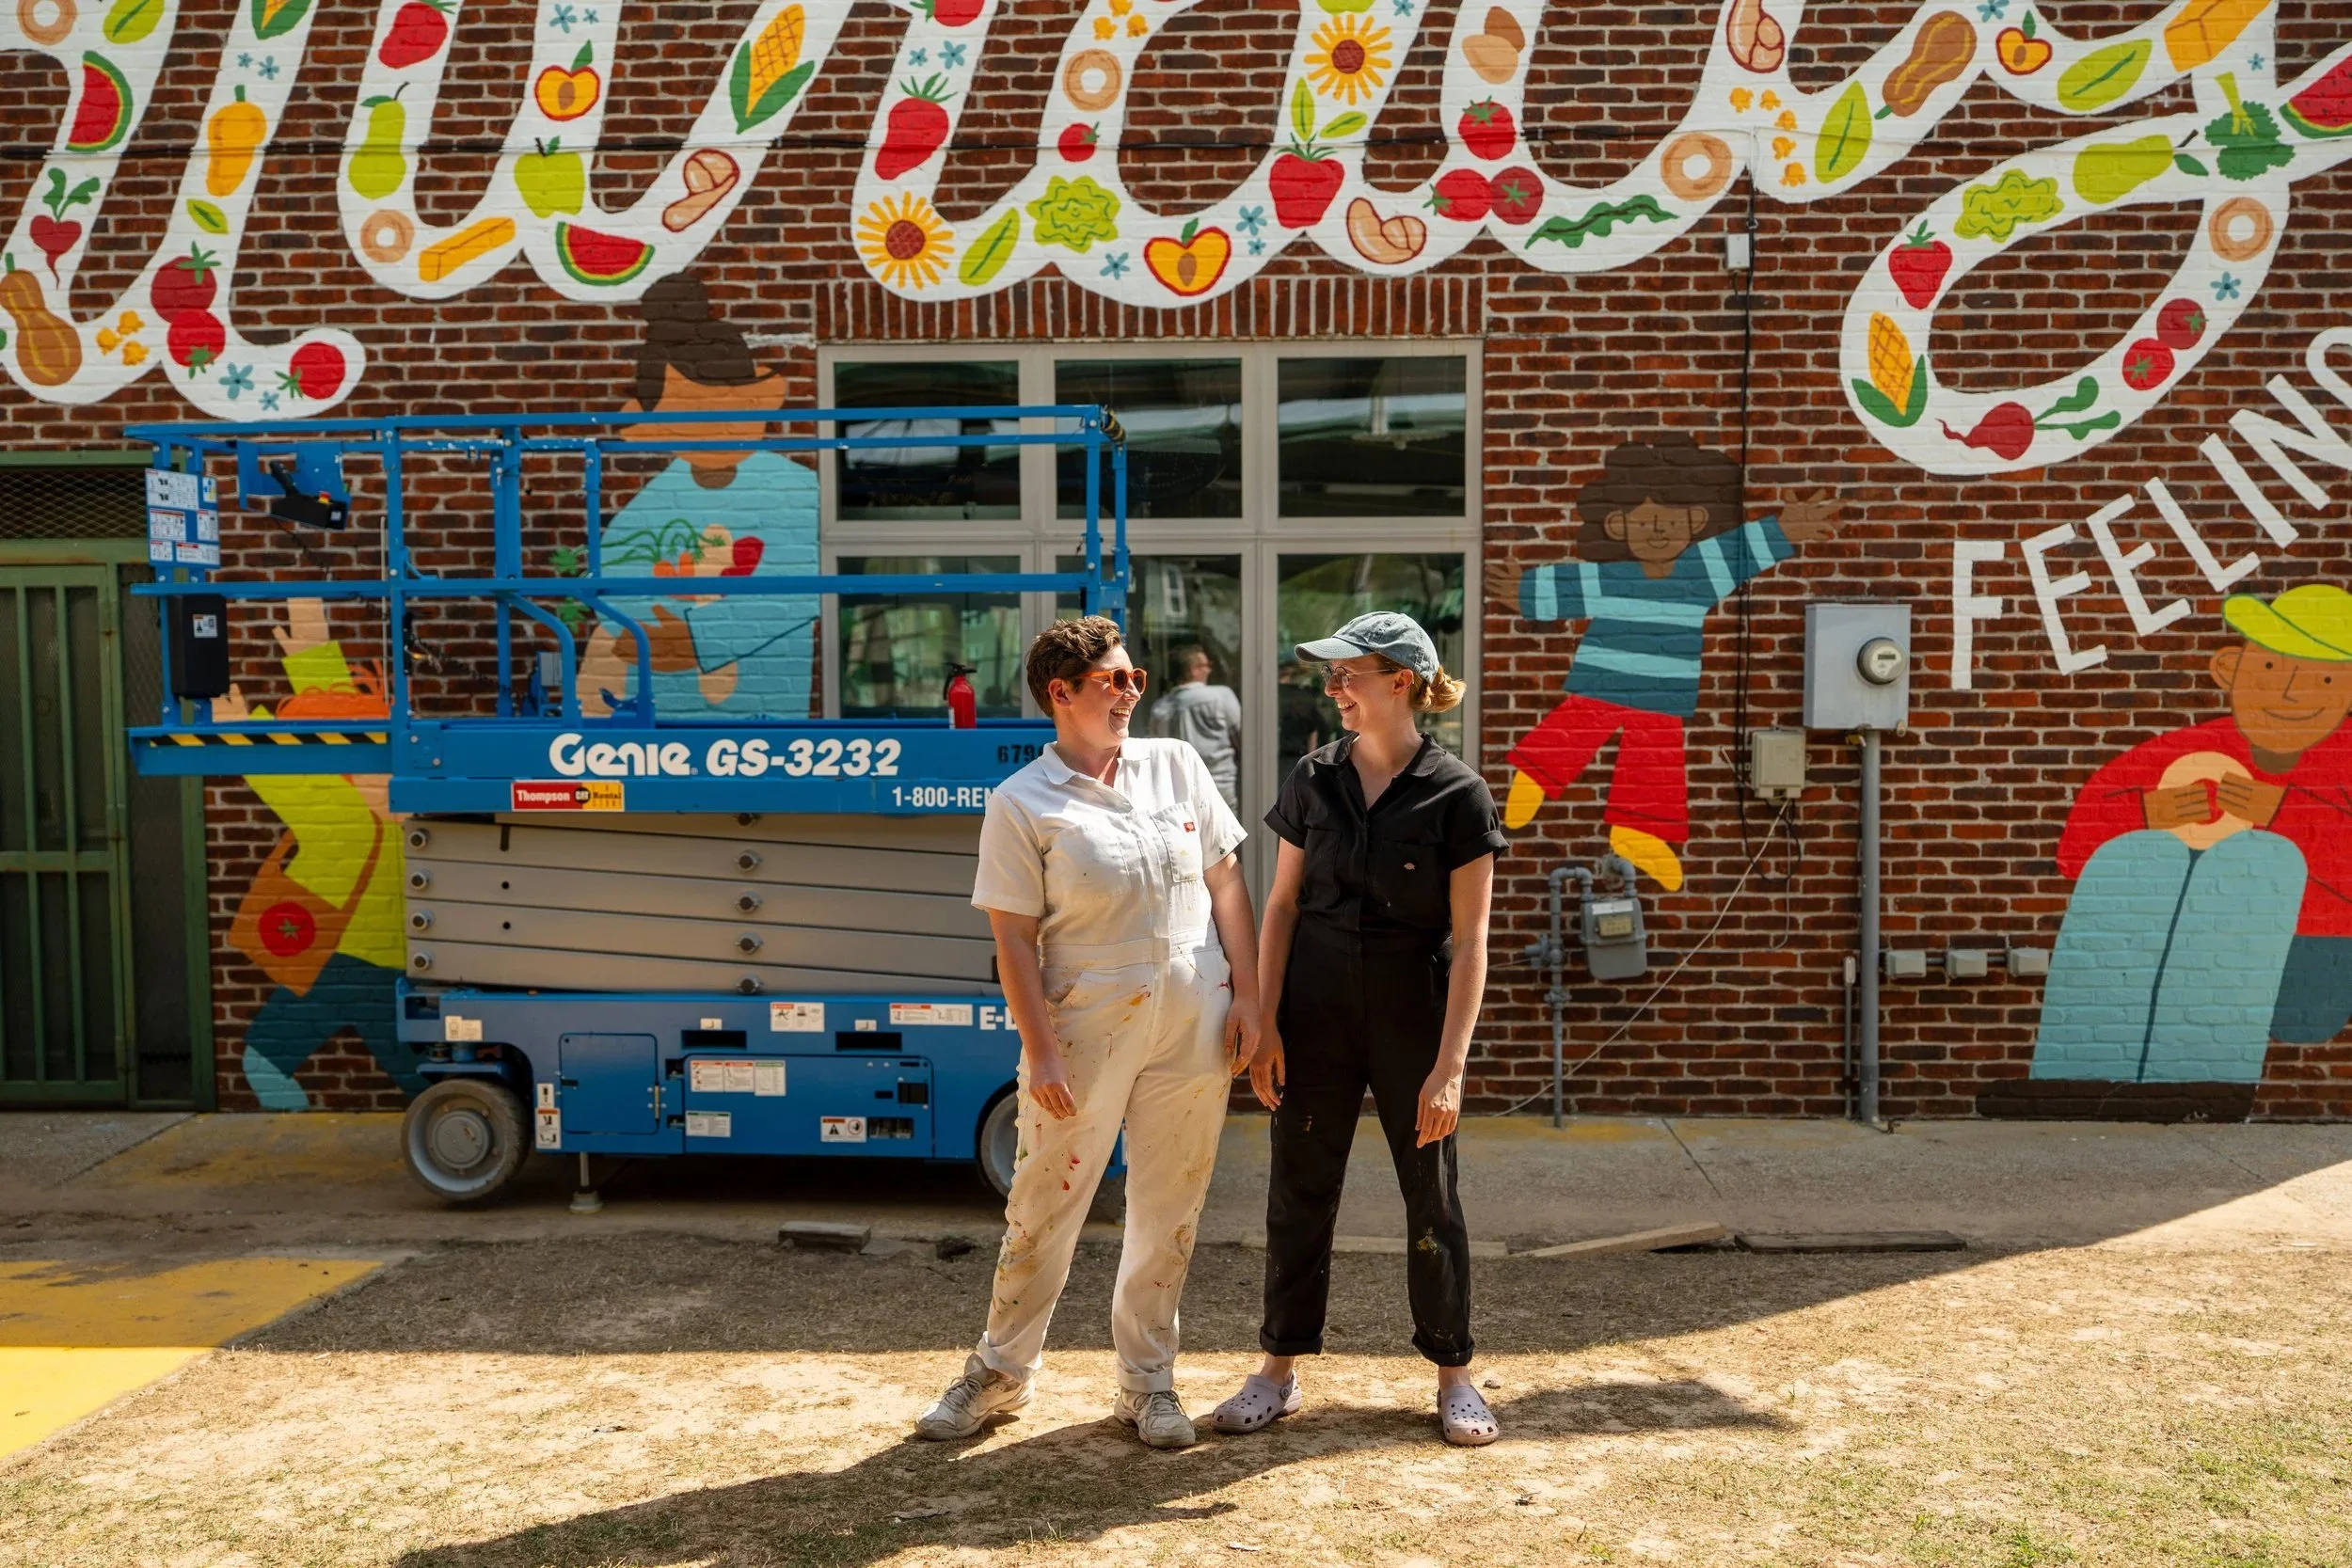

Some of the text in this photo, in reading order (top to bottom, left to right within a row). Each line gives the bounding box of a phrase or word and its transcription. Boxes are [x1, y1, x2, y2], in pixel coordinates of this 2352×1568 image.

[548, 732, 902, 777] Genie GS-3232
[516, 790, 570, 804] Thompson
